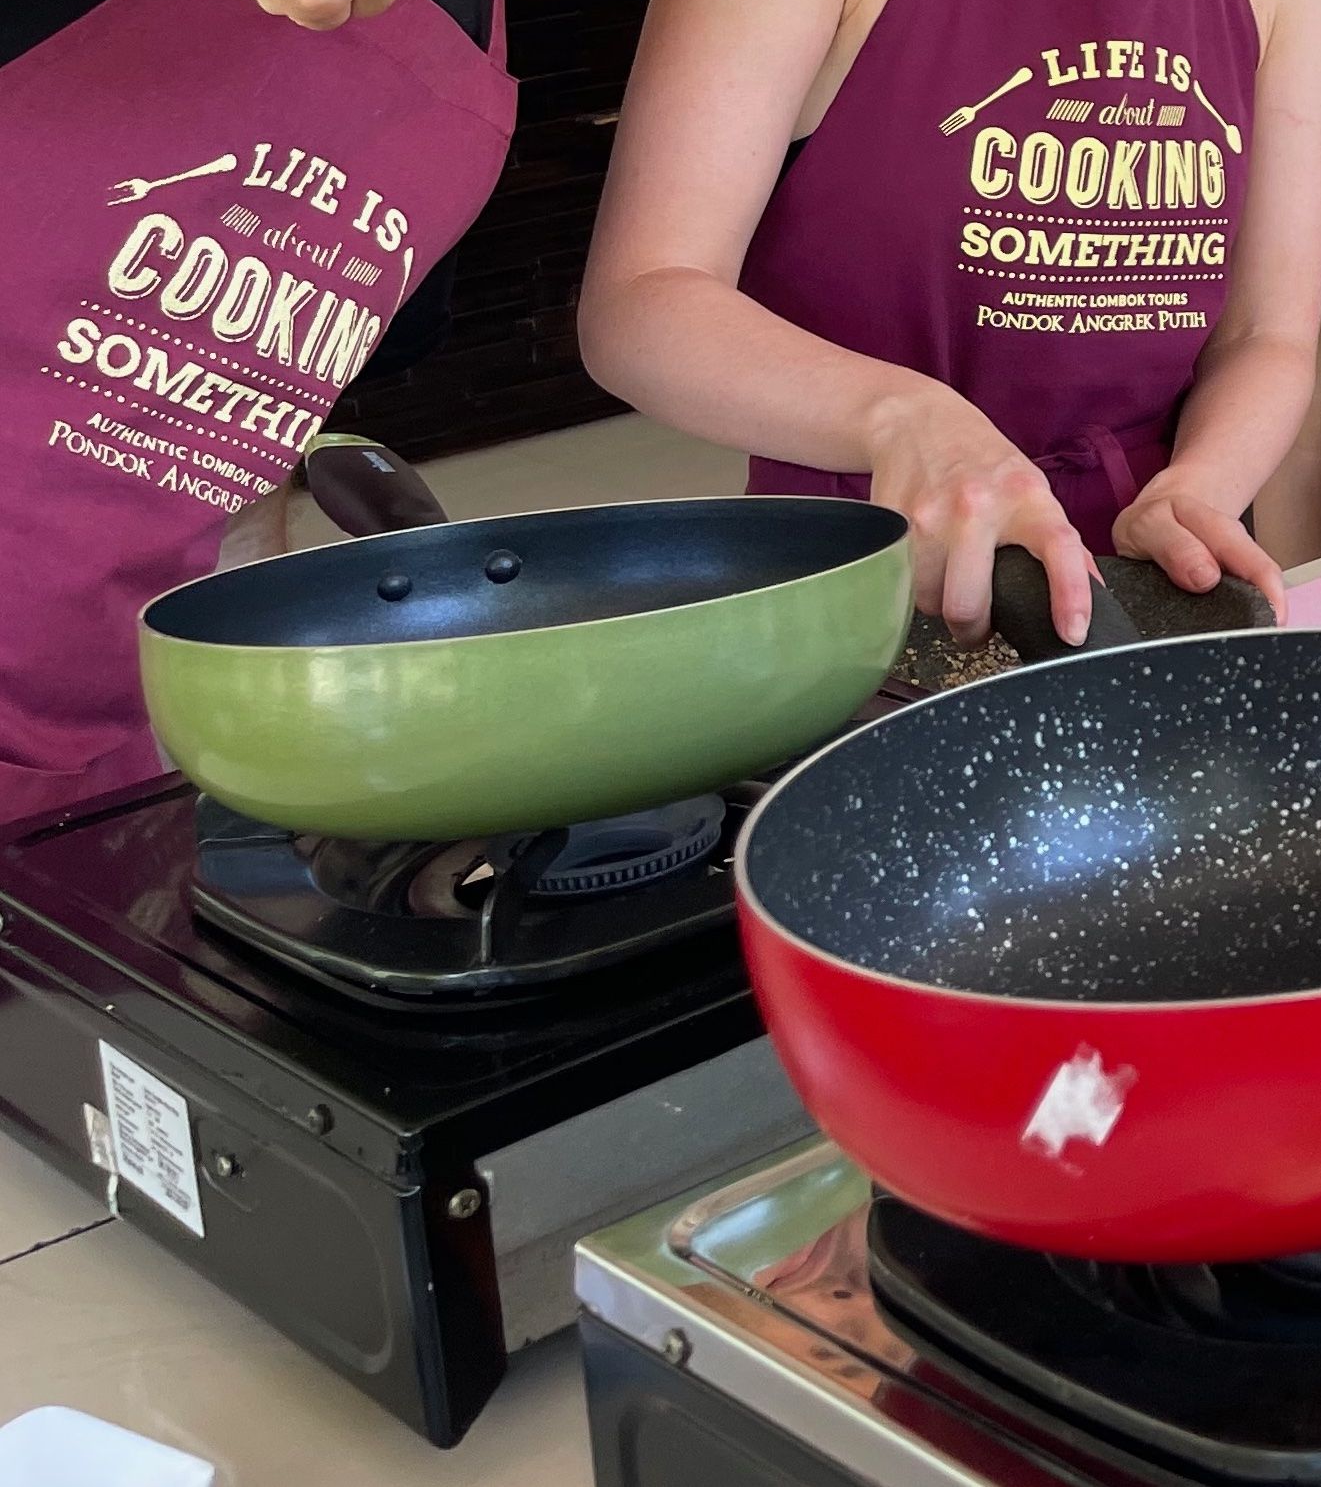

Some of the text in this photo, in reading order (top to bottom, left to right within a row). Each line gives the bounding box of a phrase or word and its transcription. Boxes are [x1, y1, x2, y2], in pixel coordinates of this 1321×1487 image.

[1041, 40, 1192, 92] LIFE IS
[1099, 93, 1155, 125] about
[970, 127, 1226, 210] COOKING
[243, 143, 409, 251] LIFE IS
[263, 223, 342, 271] about
[961, 222, 1225, 267] SOMETHING
[977, 305, 1207, 333] PONDOK ANGGREK PUTIH
[1002, 292, 1188, 308] AUTHENTIC LOMBOK TOURS
[57, 318, 325, 453] SOMETHI
[47, 420, 154, 480] PONDOK
[87, 413, 255, 487] AUTHENTIC LOMBOK
